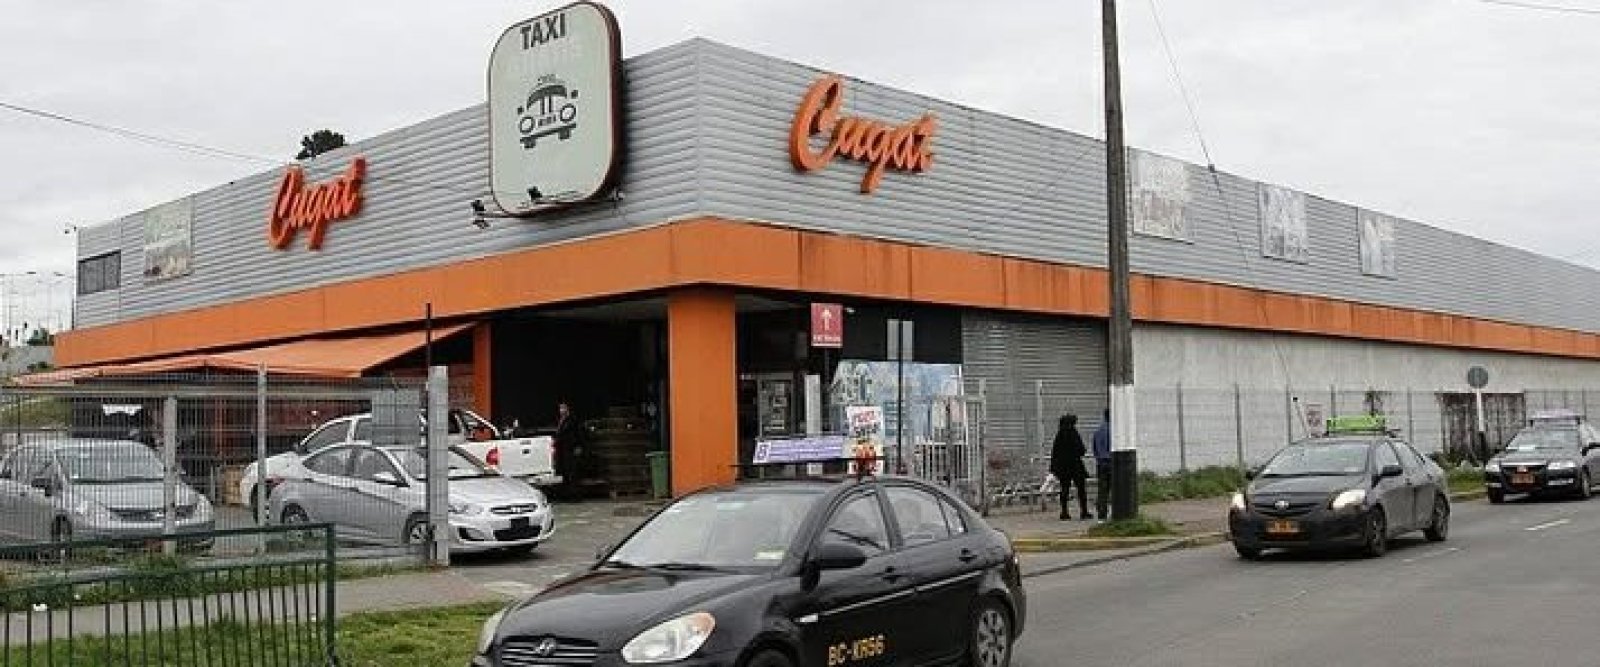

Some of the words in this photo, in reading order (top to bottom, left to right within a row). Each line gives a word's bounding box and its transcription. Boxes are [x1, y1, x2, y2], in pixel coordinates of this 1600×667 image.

[520, 13, 566, 50] TAXI
[789, 75, 936, 194] Cugat
[268, 156, 365, 250] Cugat
